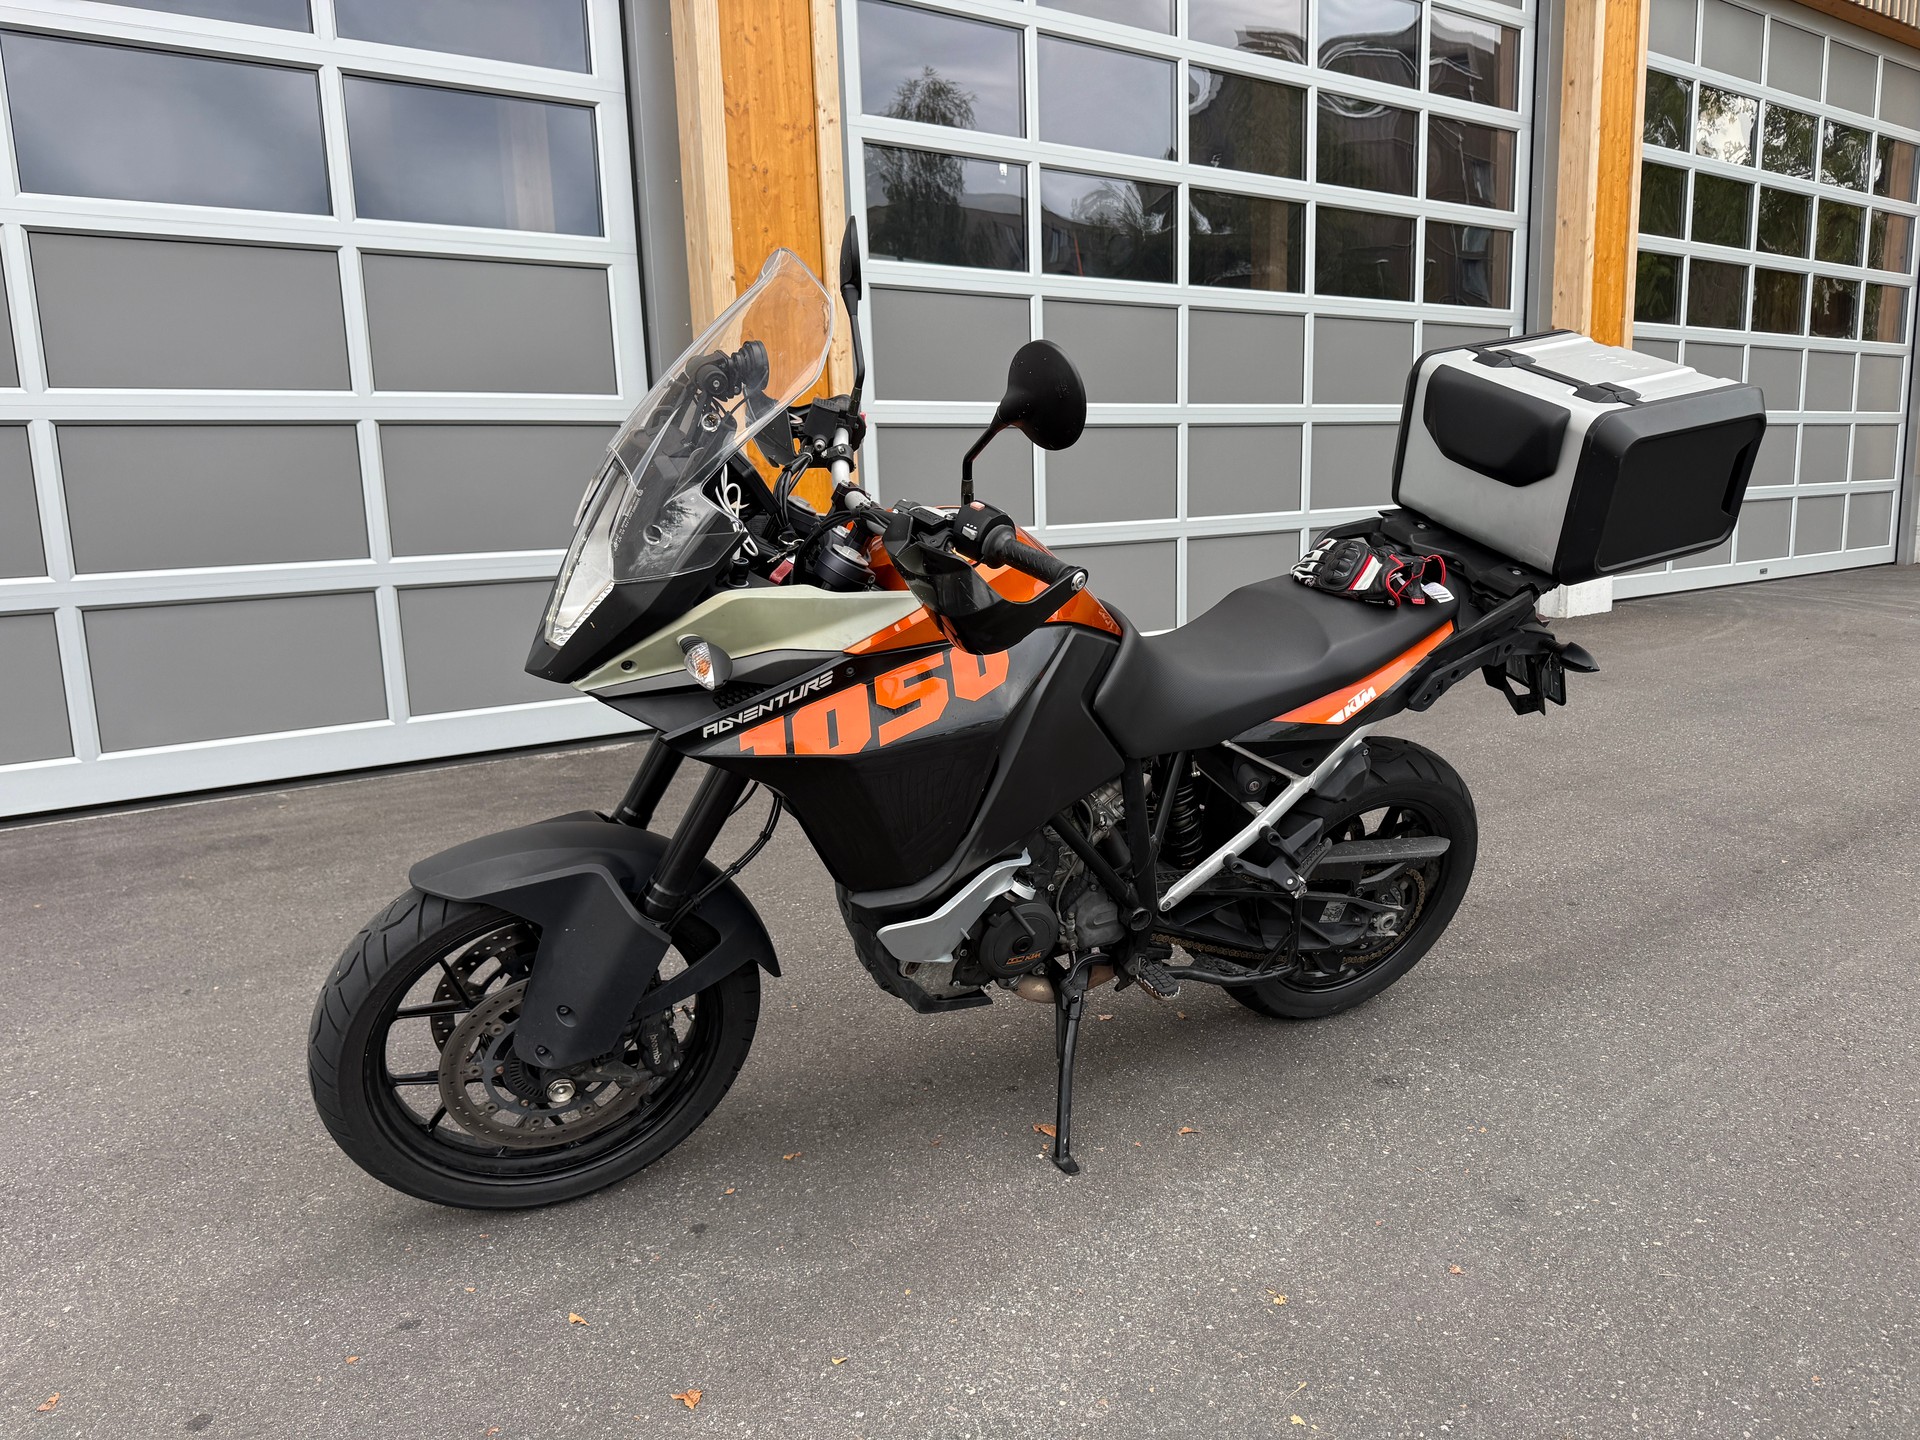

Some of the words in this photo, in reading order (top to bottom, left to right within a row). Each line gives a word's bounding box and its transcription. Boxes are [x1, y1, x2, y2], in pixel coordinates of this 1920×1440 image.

[702, 670, 834, 739] ADVENTURE
[738, 646, 1010, 755] 1050
[1342, 685, 1377, 719] KTM
